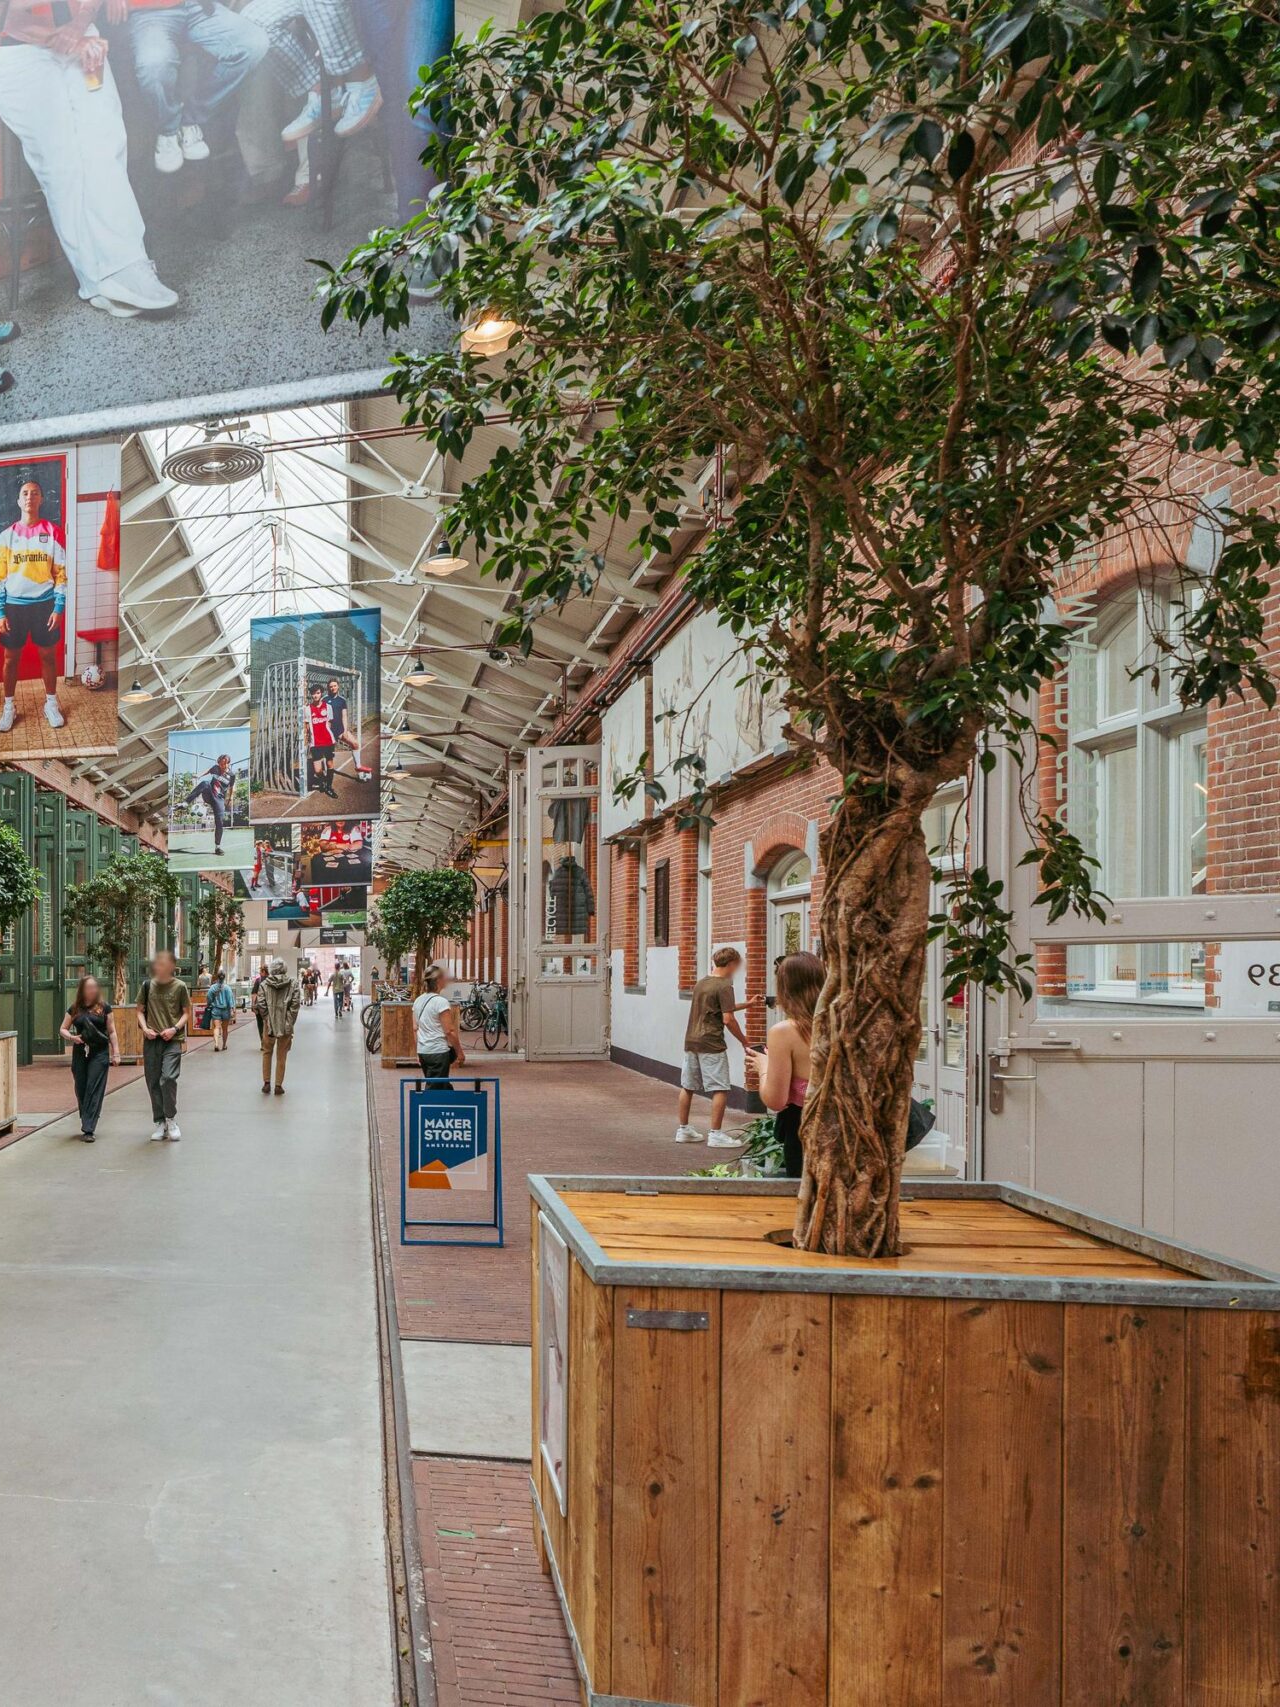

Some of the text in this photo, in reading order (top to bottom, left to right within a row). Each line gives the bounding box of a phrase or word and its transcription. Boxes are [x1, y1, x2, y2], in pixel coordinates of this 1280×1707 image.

[545, 895, 557, 941] RECYCLE
[424, 1118, 472, 1129] MAKER
[424, 1129, 472, 1141] STORE
